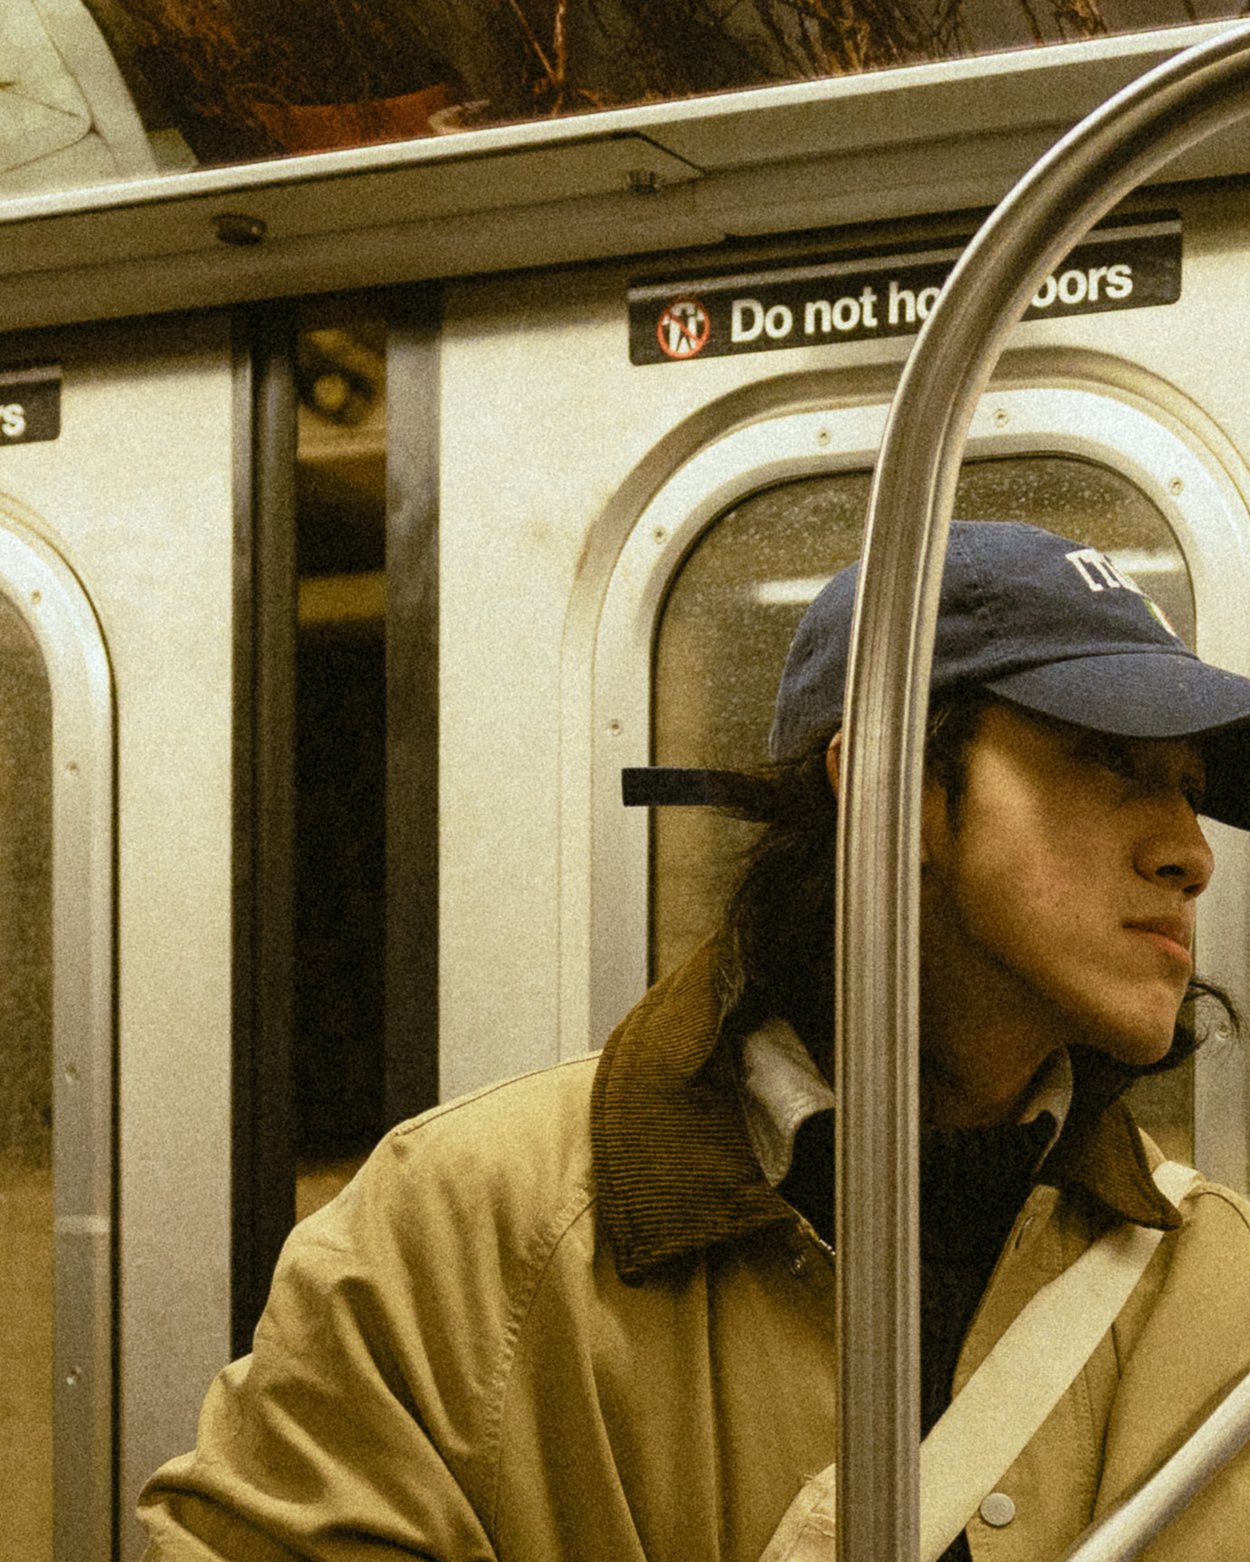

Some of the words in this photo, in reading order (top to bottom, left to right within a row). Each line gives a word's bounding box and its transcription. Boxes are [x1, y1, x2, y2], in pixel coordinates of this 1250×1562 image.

[731, 299, 793, 344] Do
[803, 285, 878, 335] not
[888, 280, 942, 326] ho
[1030, 262, 1134, 309] oors
